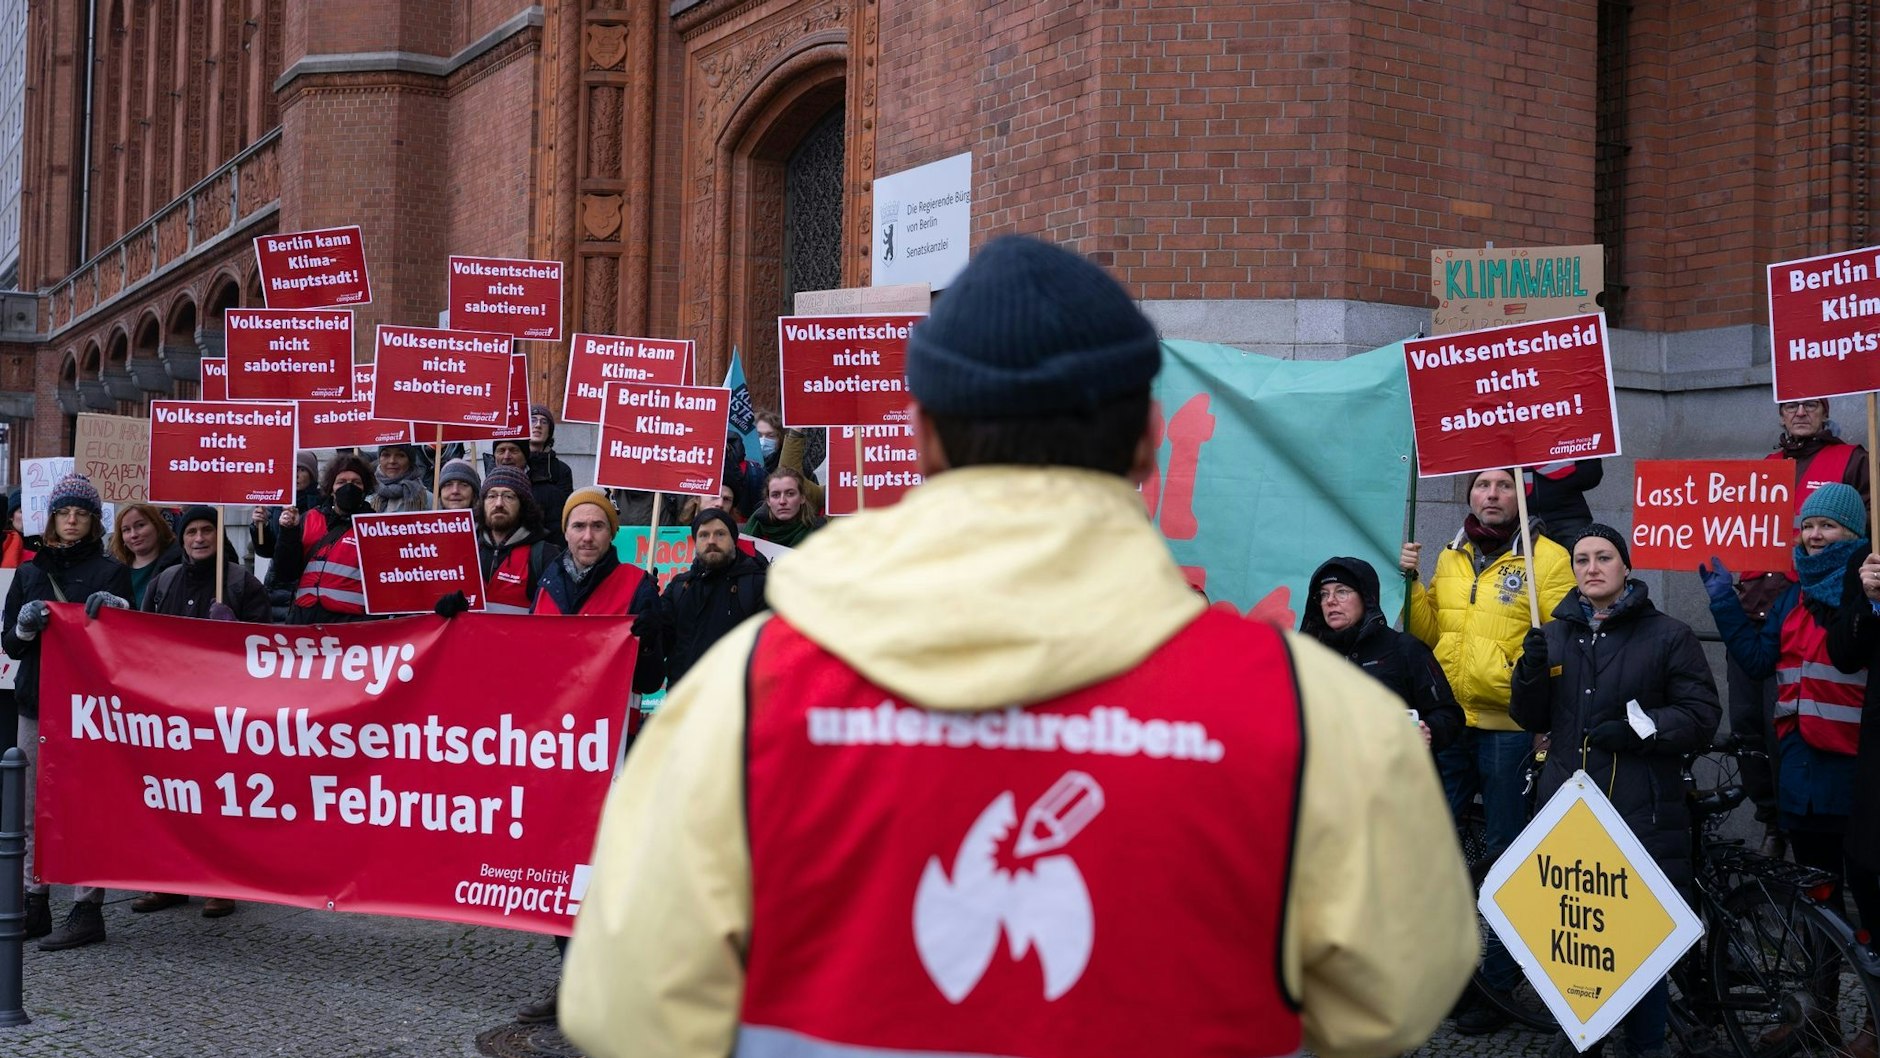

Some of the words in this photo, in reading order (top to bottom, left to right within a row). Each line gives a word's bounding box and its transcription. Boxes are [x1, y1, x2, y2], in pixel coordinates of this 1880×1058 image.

[907, 203, 918, 216] Die
[918, 194, 954, 215] Regierende
[906, 222, 918, 234] von
[919, 217, 938, 231] Berlin
[268, 237, 313, 252] Berlin
[315, 233, 351, 248] kann
[906, 238, 949, 259] Senatskanzlei
[288, 255, 338, 270] Klima-
[453, 262, 559, 279] Volksentscheid
[272, 270, 360, 291] Hauptstadt!
[1446, 256, 1588, 300] KLIMAWAHL
[1789, 259, 1868, 292] Berlin
[488, 281, 525, 296] nicht
[464, 301, 546, 316] sabotieren!
[229, 315, 349, 331] Volksentscheid
[785, 323, 914, 341] Volksentschei
[269, 336, 310, 351] nicht
[382, 332, 509, 354] Volksentscheid
[585, 340, 634, 357] Berlin
[637, 343, 675, 360] kann
[1410, 324, 1597, 370] Volksentscheid
[1789, 331, 1880, 361] Haupts
[244, 357, 335, 373] sabotieren!
[422, 357, 466, 373] nicht
[833, 350, 881, 366] nicht
[602, 363, 654, 380] Klima-
[1475, 367, 1540, 394] nicht
[393, 378, 491, 397] sabotieren!
[803, 376, 915, 393] sabotieren!
[618, 388, 670, 408] Berlin
[674, 391, 717, 412] kann
[156, 408, 292, 427] Volksentscheid
[1440, 394, 1584, 432] sabotieren!
[81, 419, 115, 438] UND
[636, 416, 693, 436] Klima-
[200, 433, 247, 450] nicht
[1550, 433, 1601, 455] campact!
[610, 440, 714, 465] Hauptstadt!
[864, 444, 920, 462] Klima
[169, 456, 275, 474] sabotieren!
[1708, 472, 1788, 503] Berlin
[358, 517, 471, 537] Volksentscheid
[1633, 524, 1693, 549] eine
[1702, 514, 1786, 548] WAHL
[399, 543, 438, 559] nicht
[379, 565, 465, 584] sabotieren!
[246, 633, 415, 695] Giffey:
[71, 694, 610, 773] Klima-Volksentscheid
[806, 701, 1225, 763] unterschreiben.
[143, 774, 202, 814] am
[215, 773, 296, 821] 12.
[311, 775, 525, 839] Februar!
[480, 863, 523, 883] Bewegt
[526, 868, 570, 885] Politik
[1537, 854, 1629, 899] Vorfahrt
[1560, 895, 1605, 933] fürs
[1551, 929, 1616, 973] Klima
